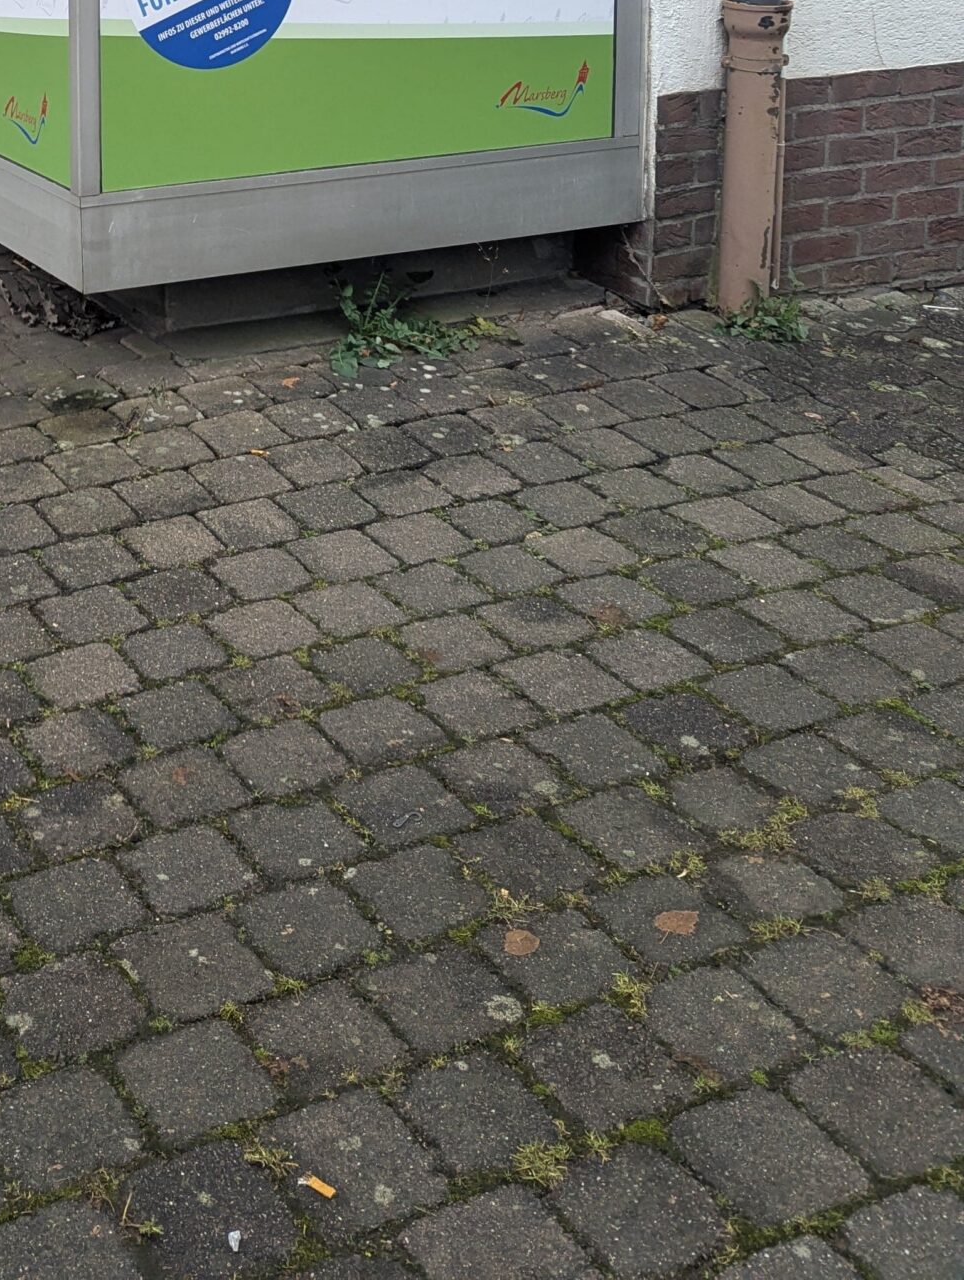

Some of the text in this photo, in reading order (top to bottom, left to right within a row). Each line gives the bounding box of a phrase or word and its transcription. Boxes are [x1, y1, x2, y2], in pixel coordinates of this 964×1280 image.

[157, 26, 177, 42] INFOS
[176, 22, 185, 33] ZU
[185, 12, 207, 29] DIESER
[206, 5, 220, 20] UND
[190, 8, 244, 39] GEWERBEFLÄCHEN
[214, 18, 249, 41] 02992-8200
[500, 81, 567, 106] Marsberg
